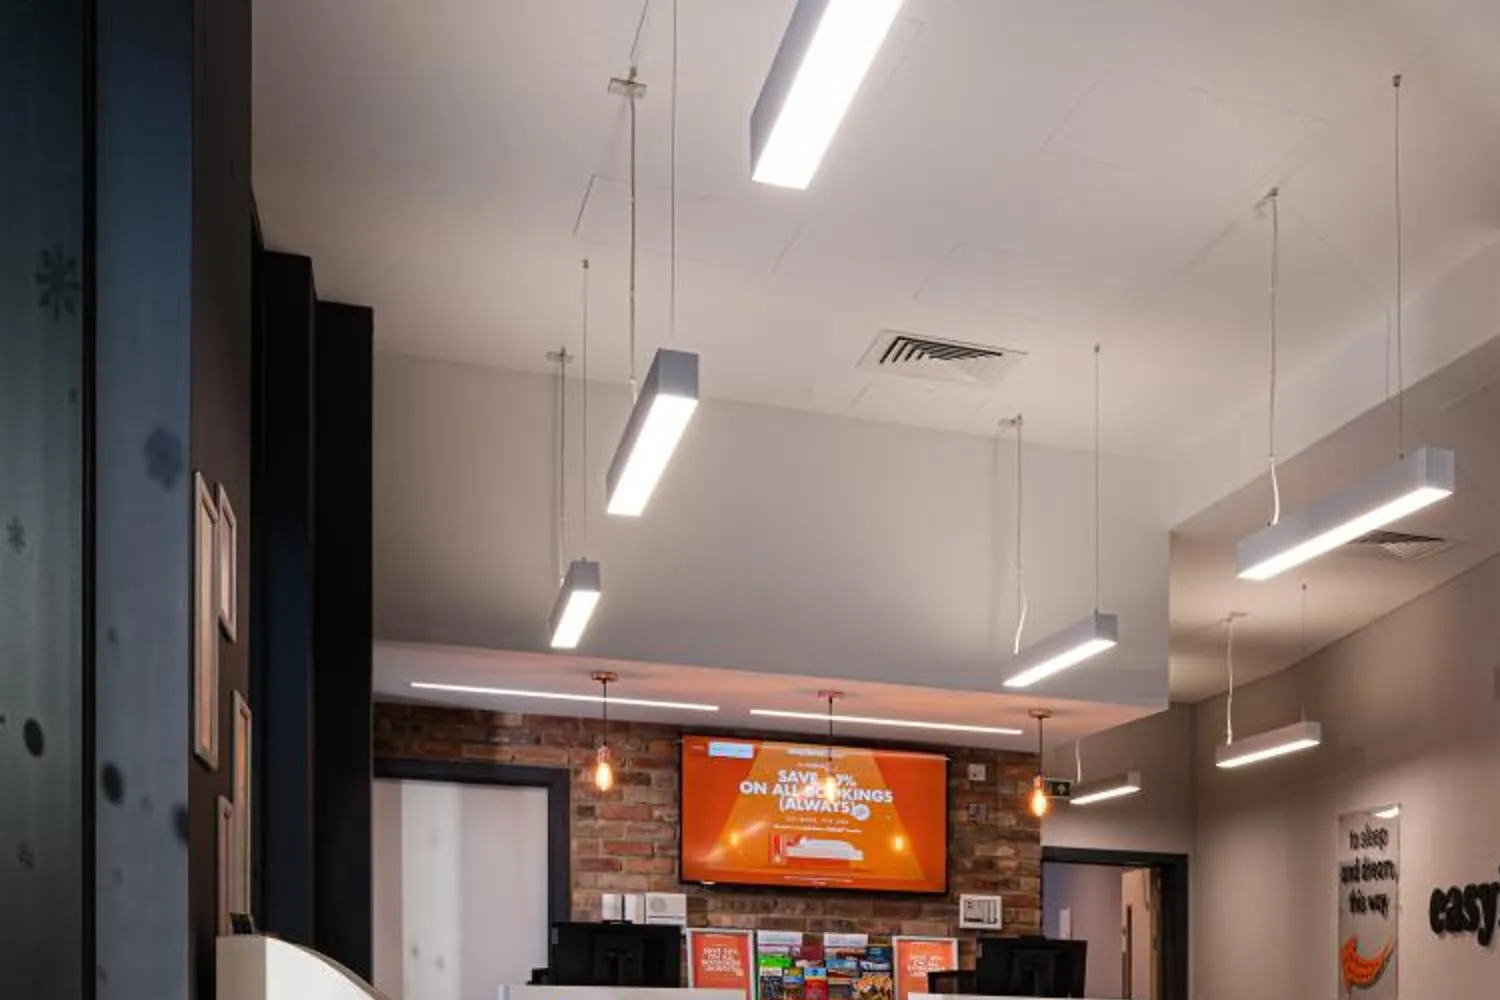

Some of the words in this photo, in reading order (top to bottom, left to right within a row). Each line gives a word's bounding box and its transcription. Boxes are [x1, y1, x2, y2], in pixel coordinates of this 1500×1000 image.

[777, 769, 818, 785] SAVE
[739, 780, 768, 795] ON
[772, 782, 800, 797] ALL
[803, 784, 894, 804] BOKINGS
[1360, 822, 1389, 851] sleep
[1349, 888, 1367, 914] this
